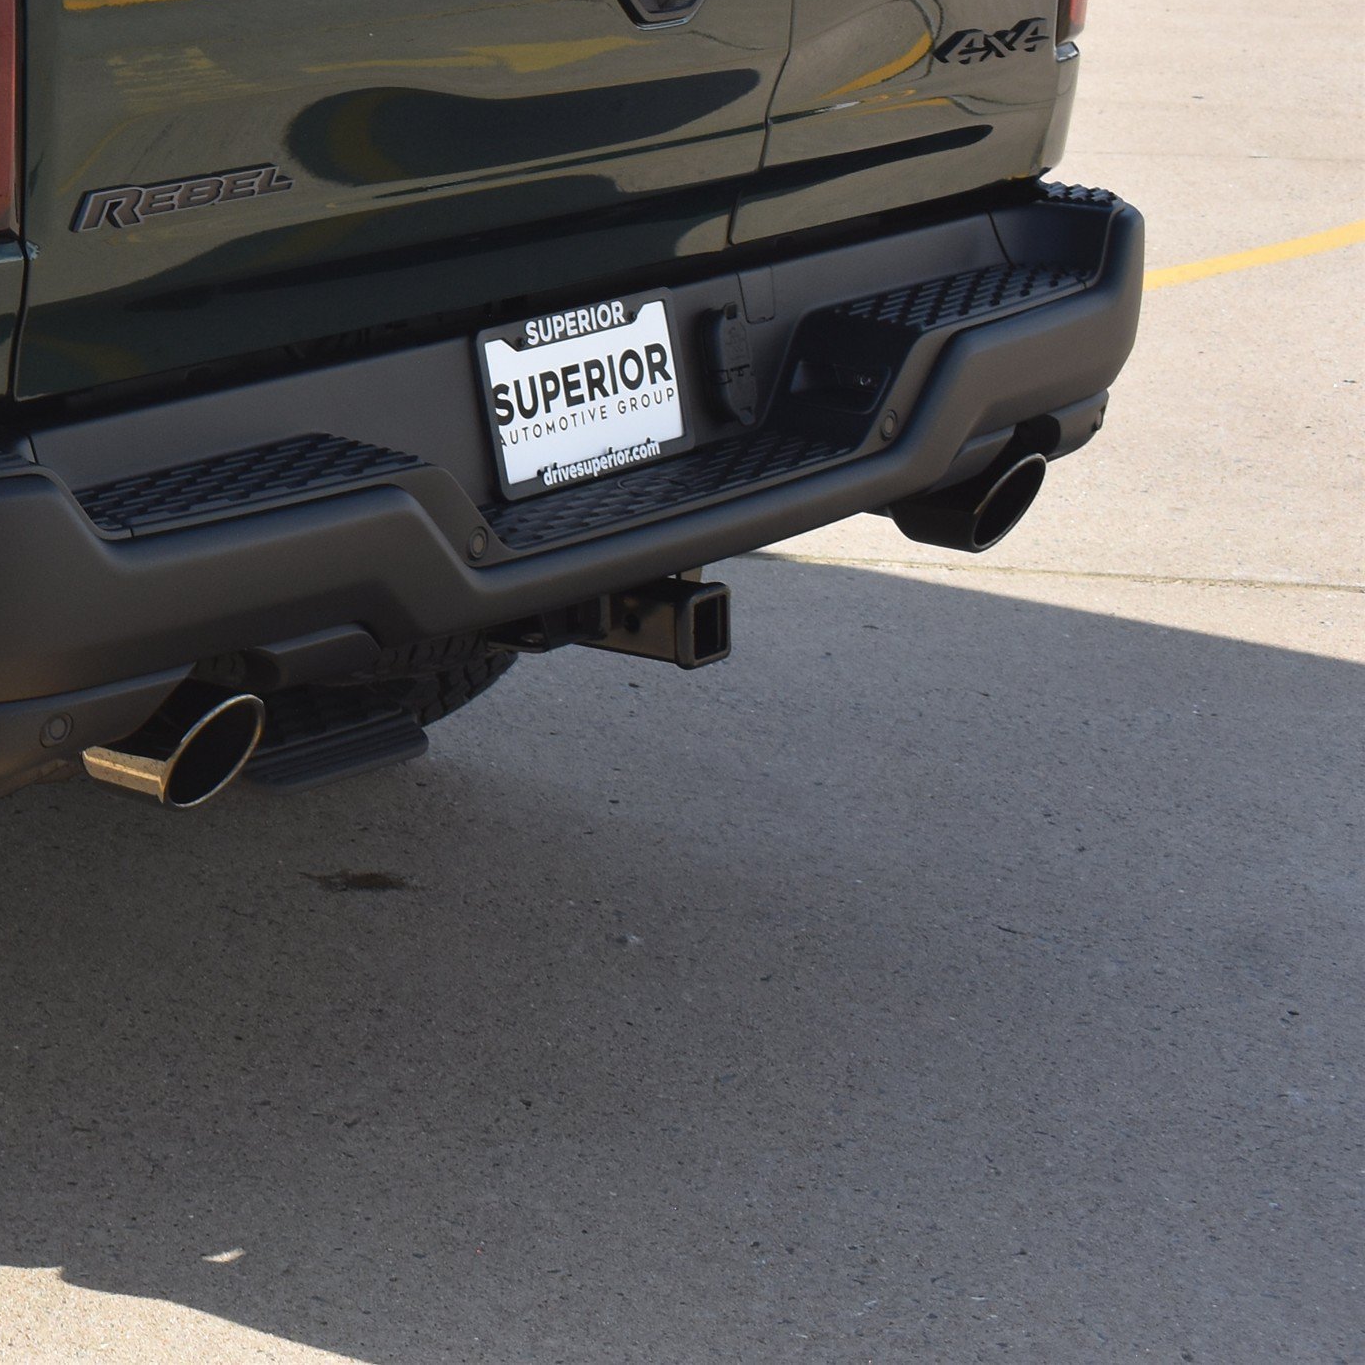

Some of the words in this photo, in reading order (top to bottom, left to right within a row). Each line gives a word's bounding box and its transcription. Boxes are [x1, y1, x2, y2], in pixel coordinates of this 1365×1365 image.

[69, 162, 296, 233] REBEL
[525, 300, 626, 346] SUPERIOR
[492, 342, 673, 427] SUPERIOR
[618, 387, 675, 415] GROUP
[542, 439, 661, 486] drivesuperior.com
